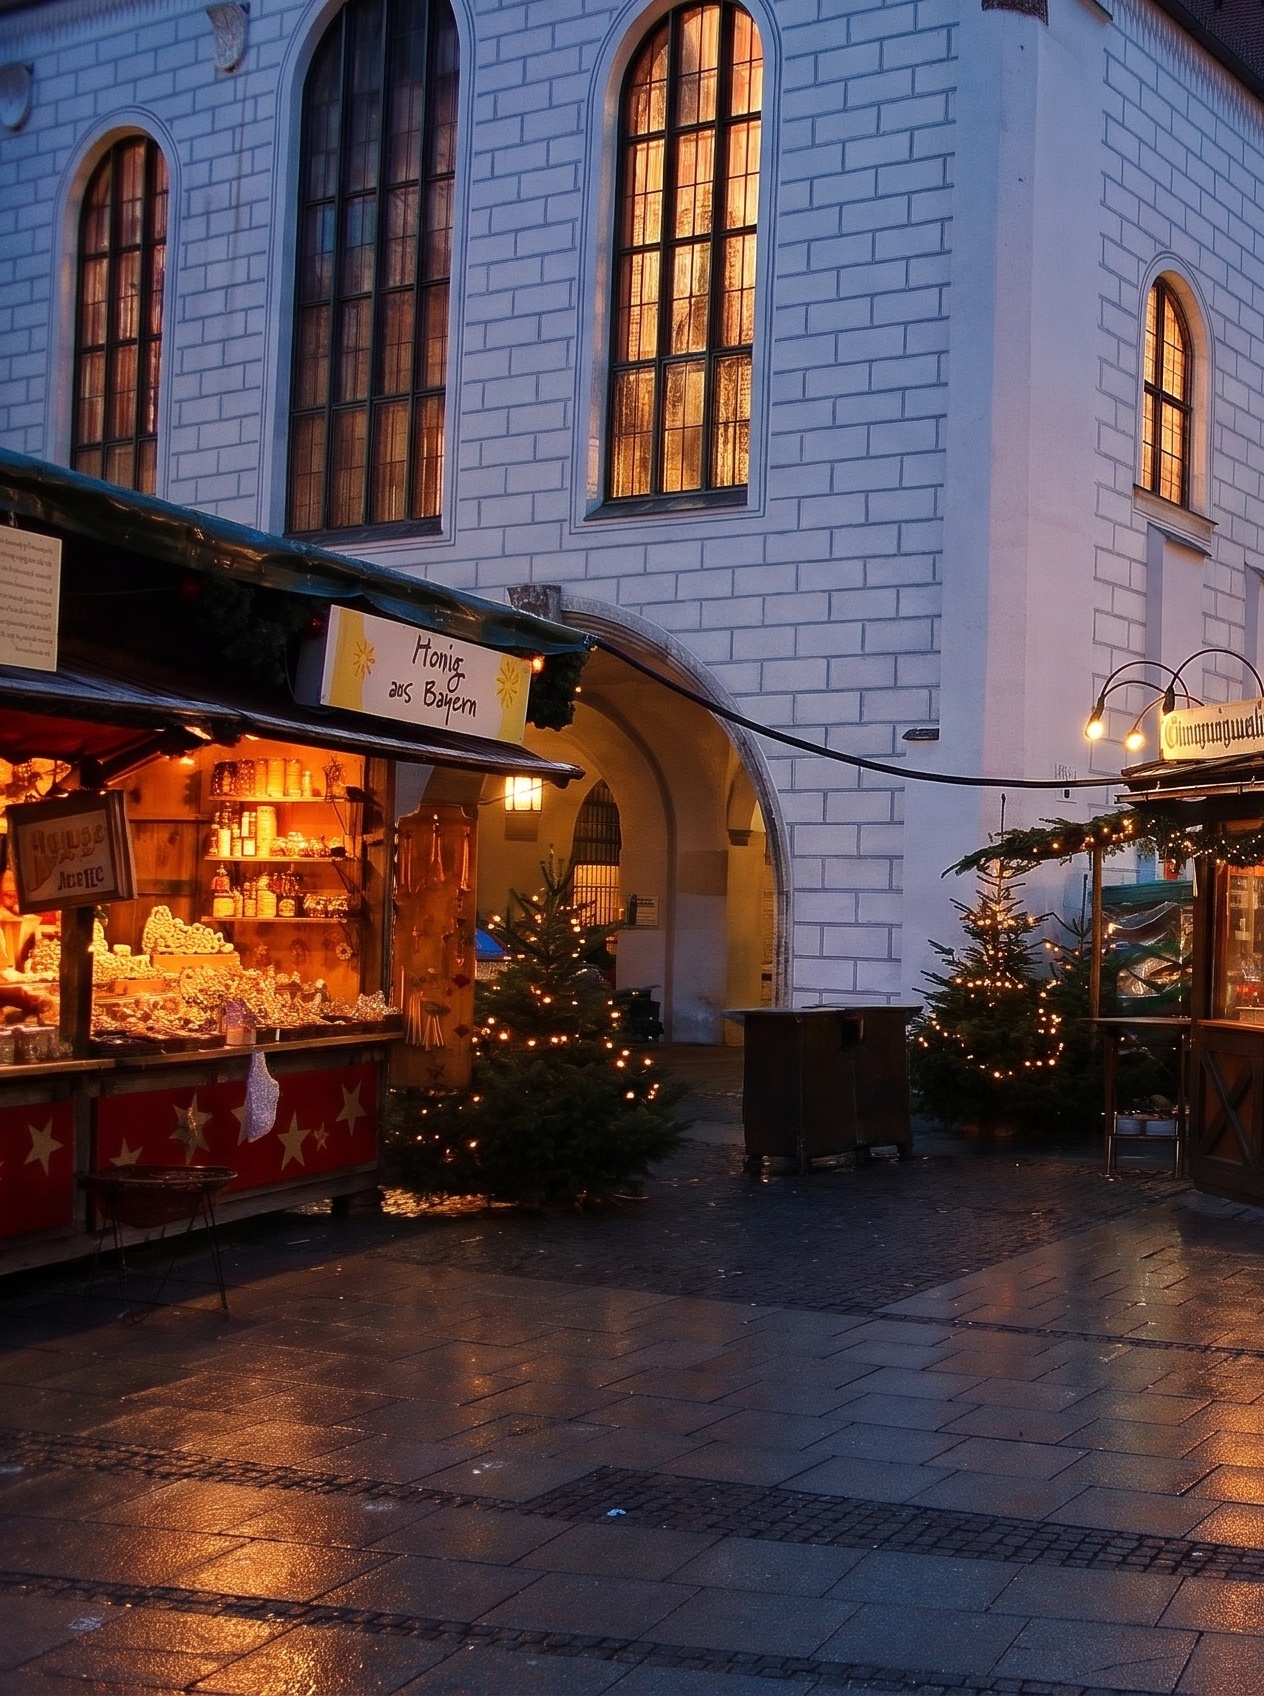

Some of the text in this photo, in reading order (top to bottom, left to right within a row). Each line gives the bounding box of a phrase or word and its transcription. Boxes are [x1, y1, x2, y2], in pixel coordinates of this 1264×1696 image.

[412, 635, 466, 693] Honig
[388, 680, 477, 726] aus Bayern
